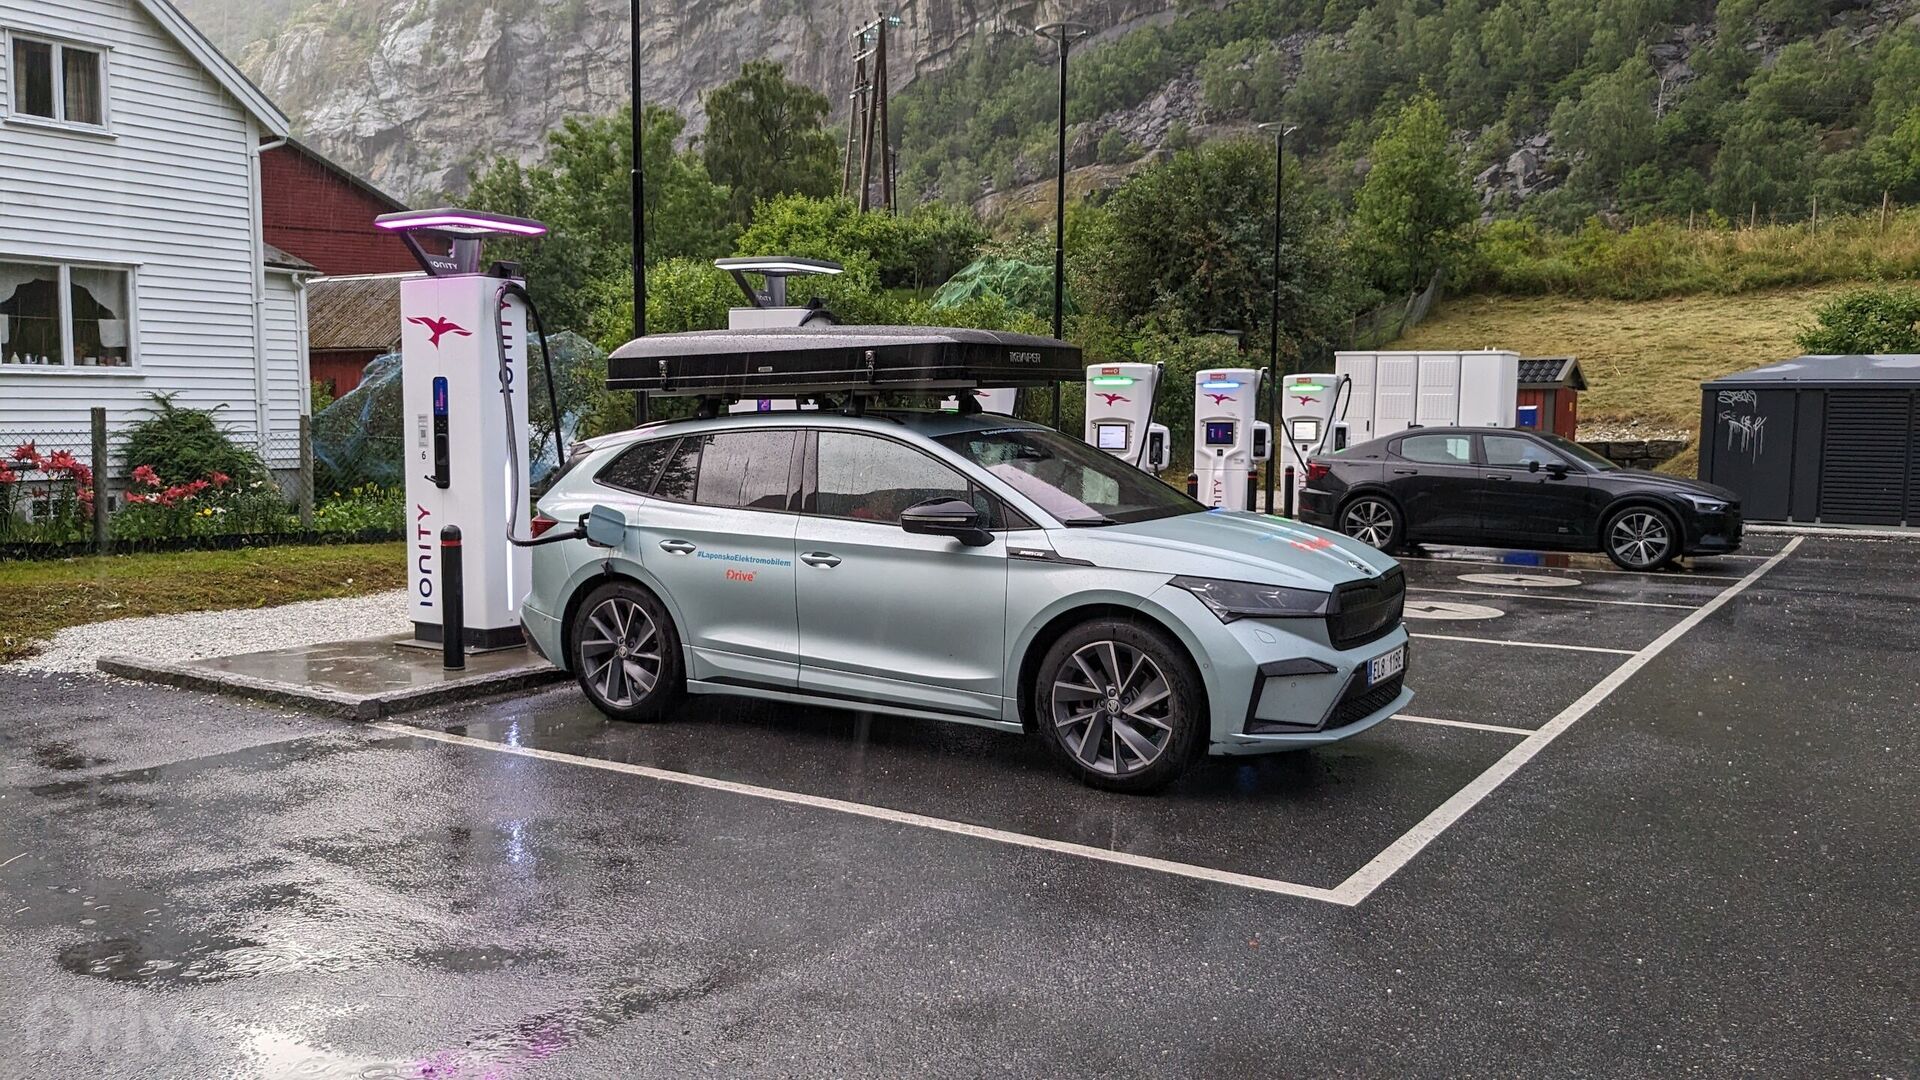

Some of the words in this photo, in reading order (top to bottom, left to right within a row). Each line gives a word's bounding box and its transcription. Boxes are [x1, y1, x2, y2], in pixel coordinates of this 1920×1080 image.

[430, 260, 457, 270] IONITY
[421, 450, 427, 460] 6
[416, 503, 433, 607] IONITY
[697, 550, 791, 567] #LaponskoElektromobilem
